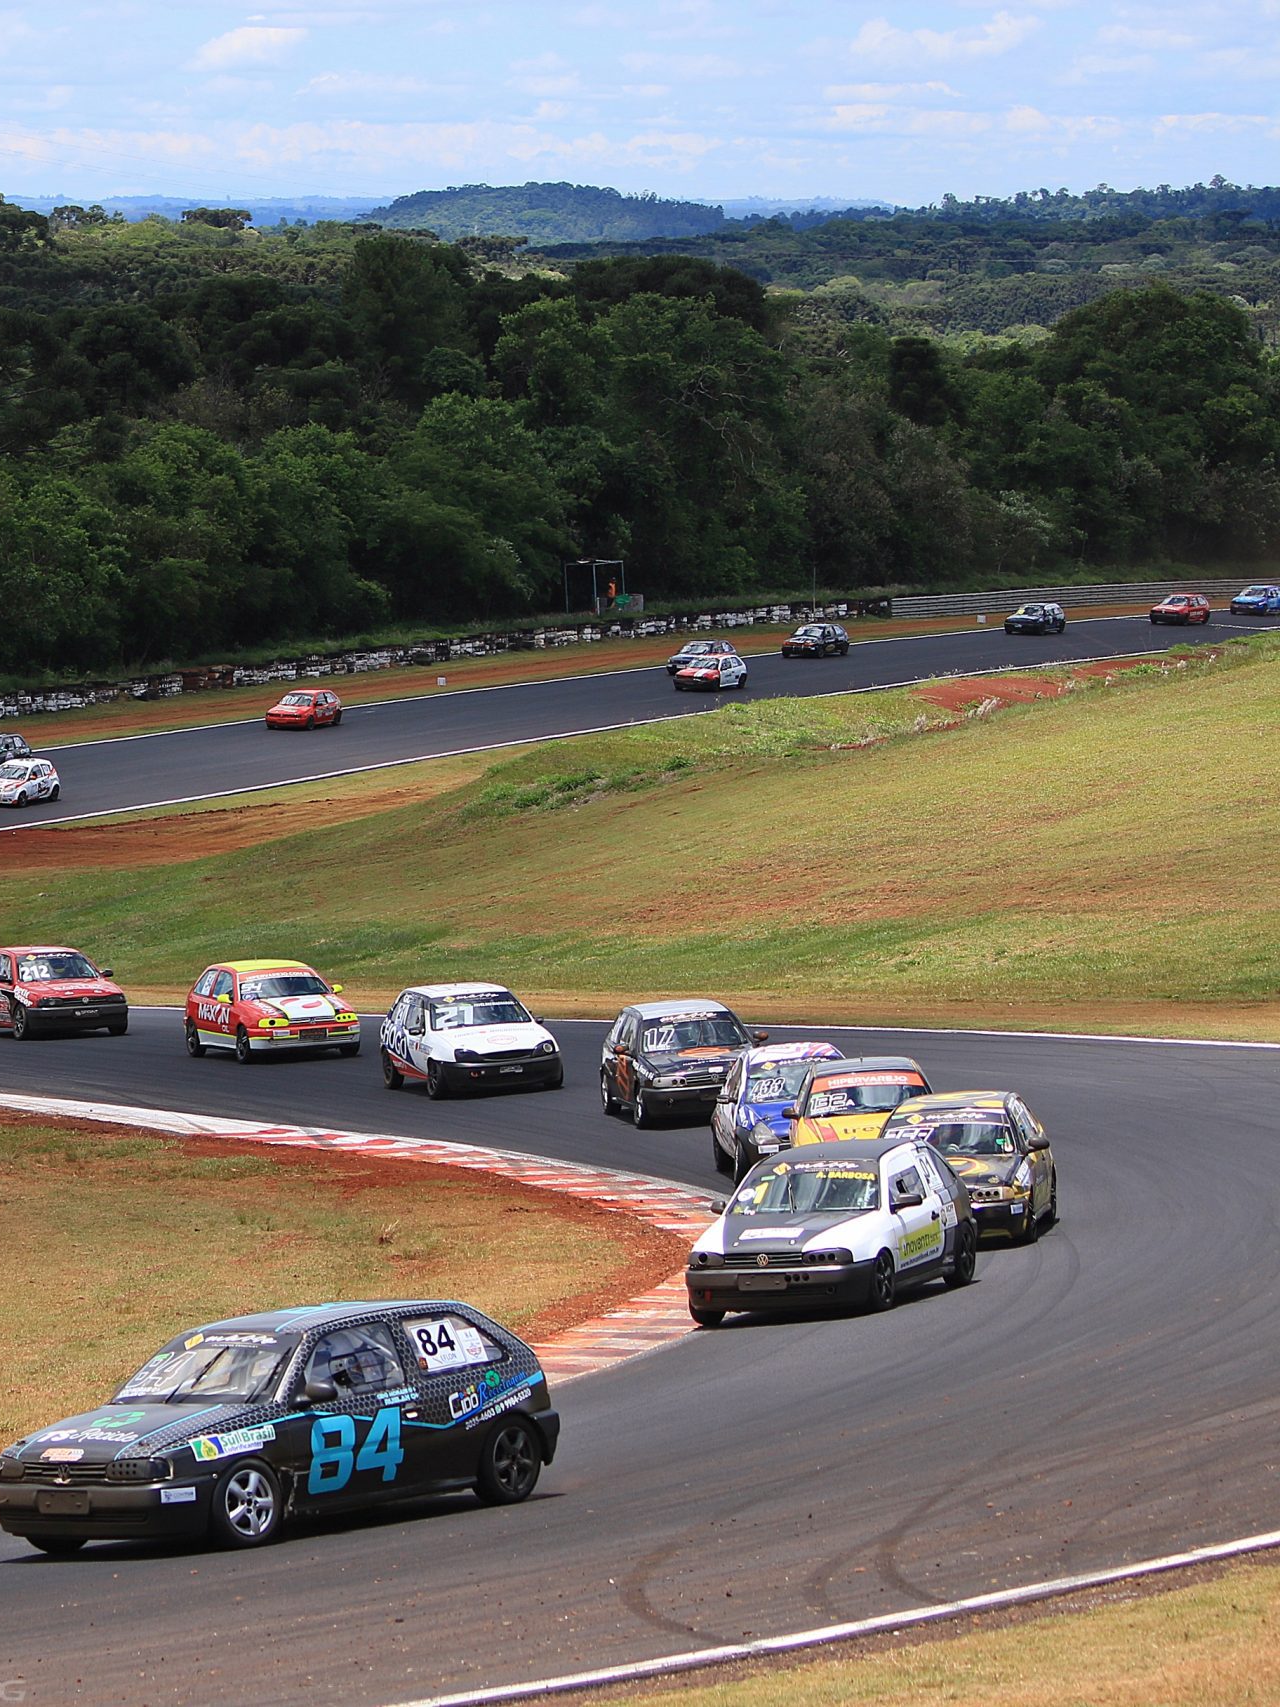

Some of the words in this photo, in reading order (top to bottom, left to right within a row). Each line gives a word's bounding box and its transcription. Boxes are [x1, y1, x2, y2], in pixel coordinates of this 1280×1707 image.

[20, 964, 50, 980] 212
[241, 982, 263, 992] 54
[435, 1005, 474, 1029] 21
[752, 1077, 785, 1098] 433
[827, 1075, 908, 1085] HIPERVAREJO
[816, 1171, 827, 1179] A.
[828, 1171, 876, 1181] BARBOSA
[416, 1324, 456, 1356] 84
[37, 1429, 77, 1443] TS
[307, 1406, 405, 1495] 84
